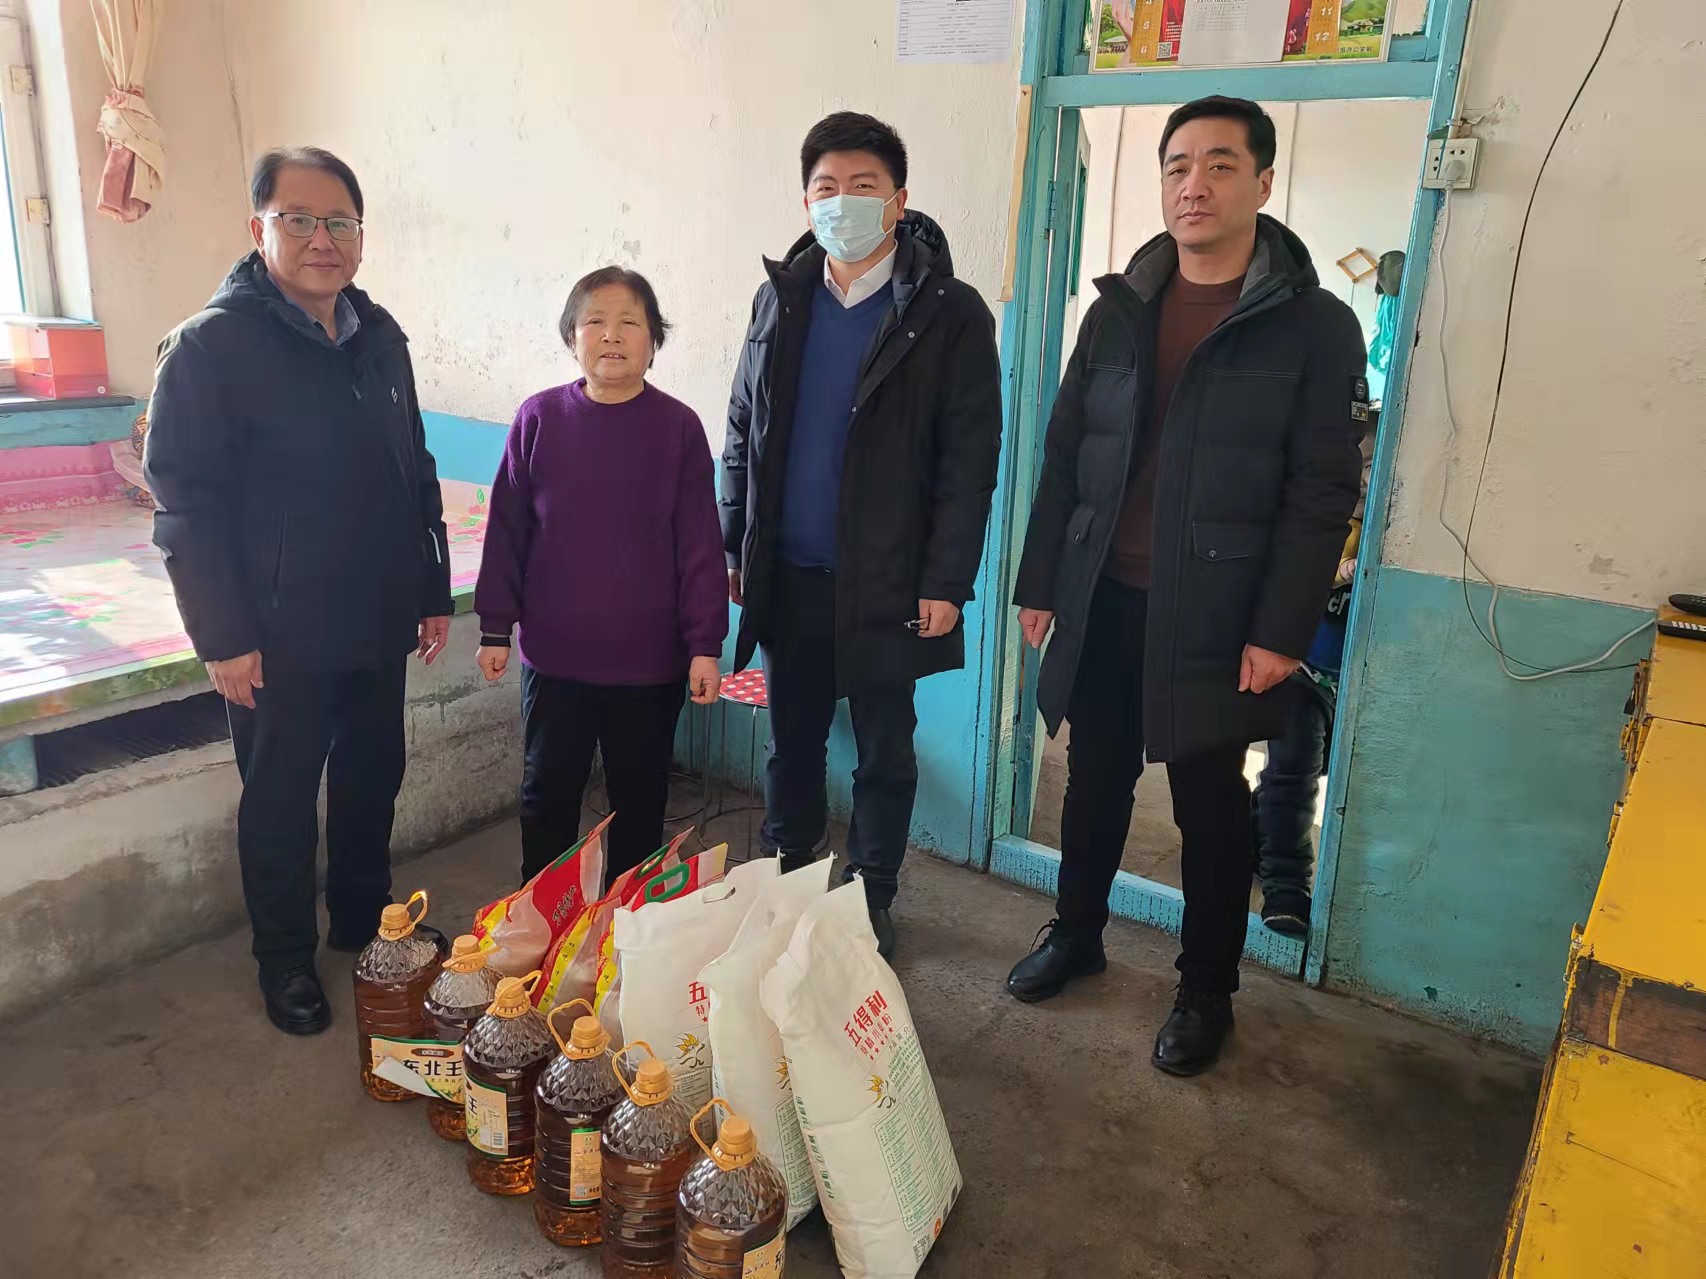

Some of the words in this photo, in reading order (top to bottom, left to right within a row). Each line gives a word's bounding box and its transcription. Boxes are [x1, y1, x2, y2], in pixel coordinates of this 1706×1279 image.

[1321, 7, 1333, 16] 11
[1315, 31, 1330, 42] 12
[844, 990, 888, 1047] 五得利
[860, 1012, 892, 1056] 特精小麦粉
[403, 1059, 463, 1077] 东北王
